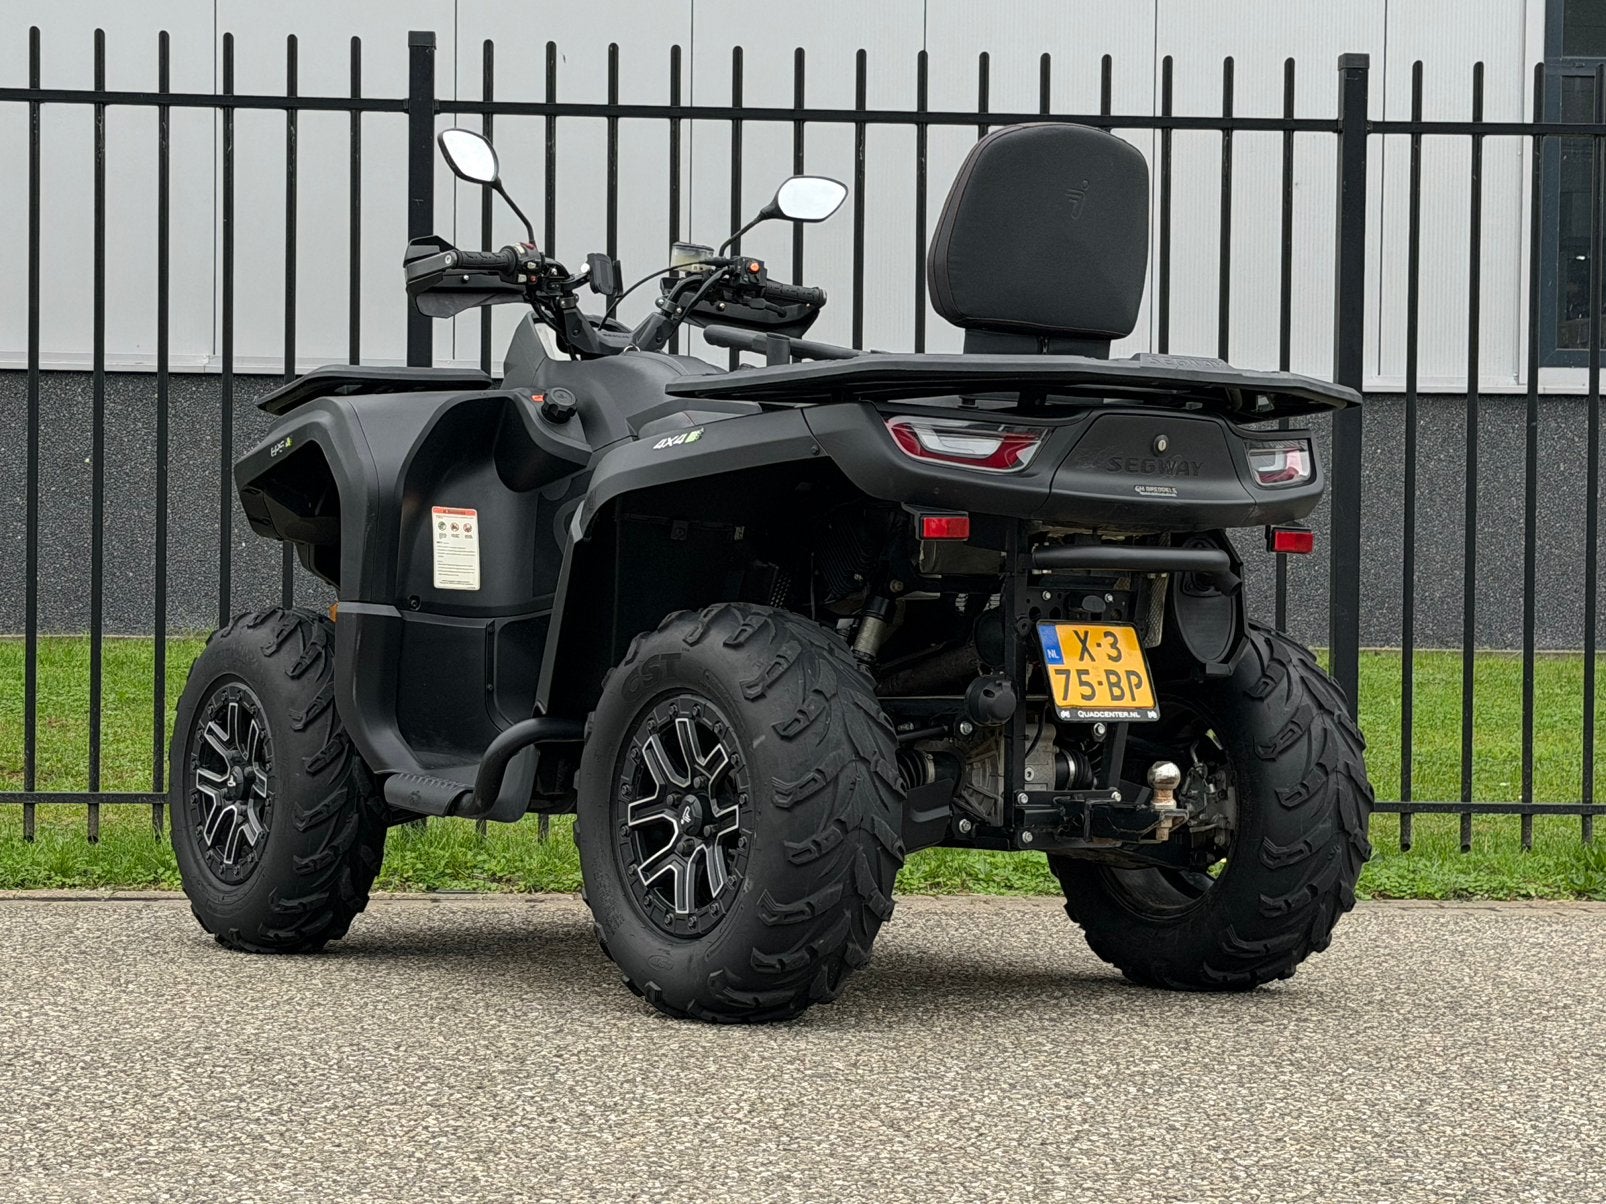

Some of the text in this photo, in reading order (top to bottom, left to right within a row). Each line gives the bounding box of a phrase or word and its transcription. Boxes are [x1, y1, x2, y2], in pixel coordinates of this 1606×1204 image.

[1105, 456, 1204, 477] SEGWAY
[1047, 649, 1060, 659] NL
[1072, 629, 1123, 663] X-3
[1054, 669, 1143, 702] 75-BP
[1077, 710, 1141, 719] QUADCENTER.NL
